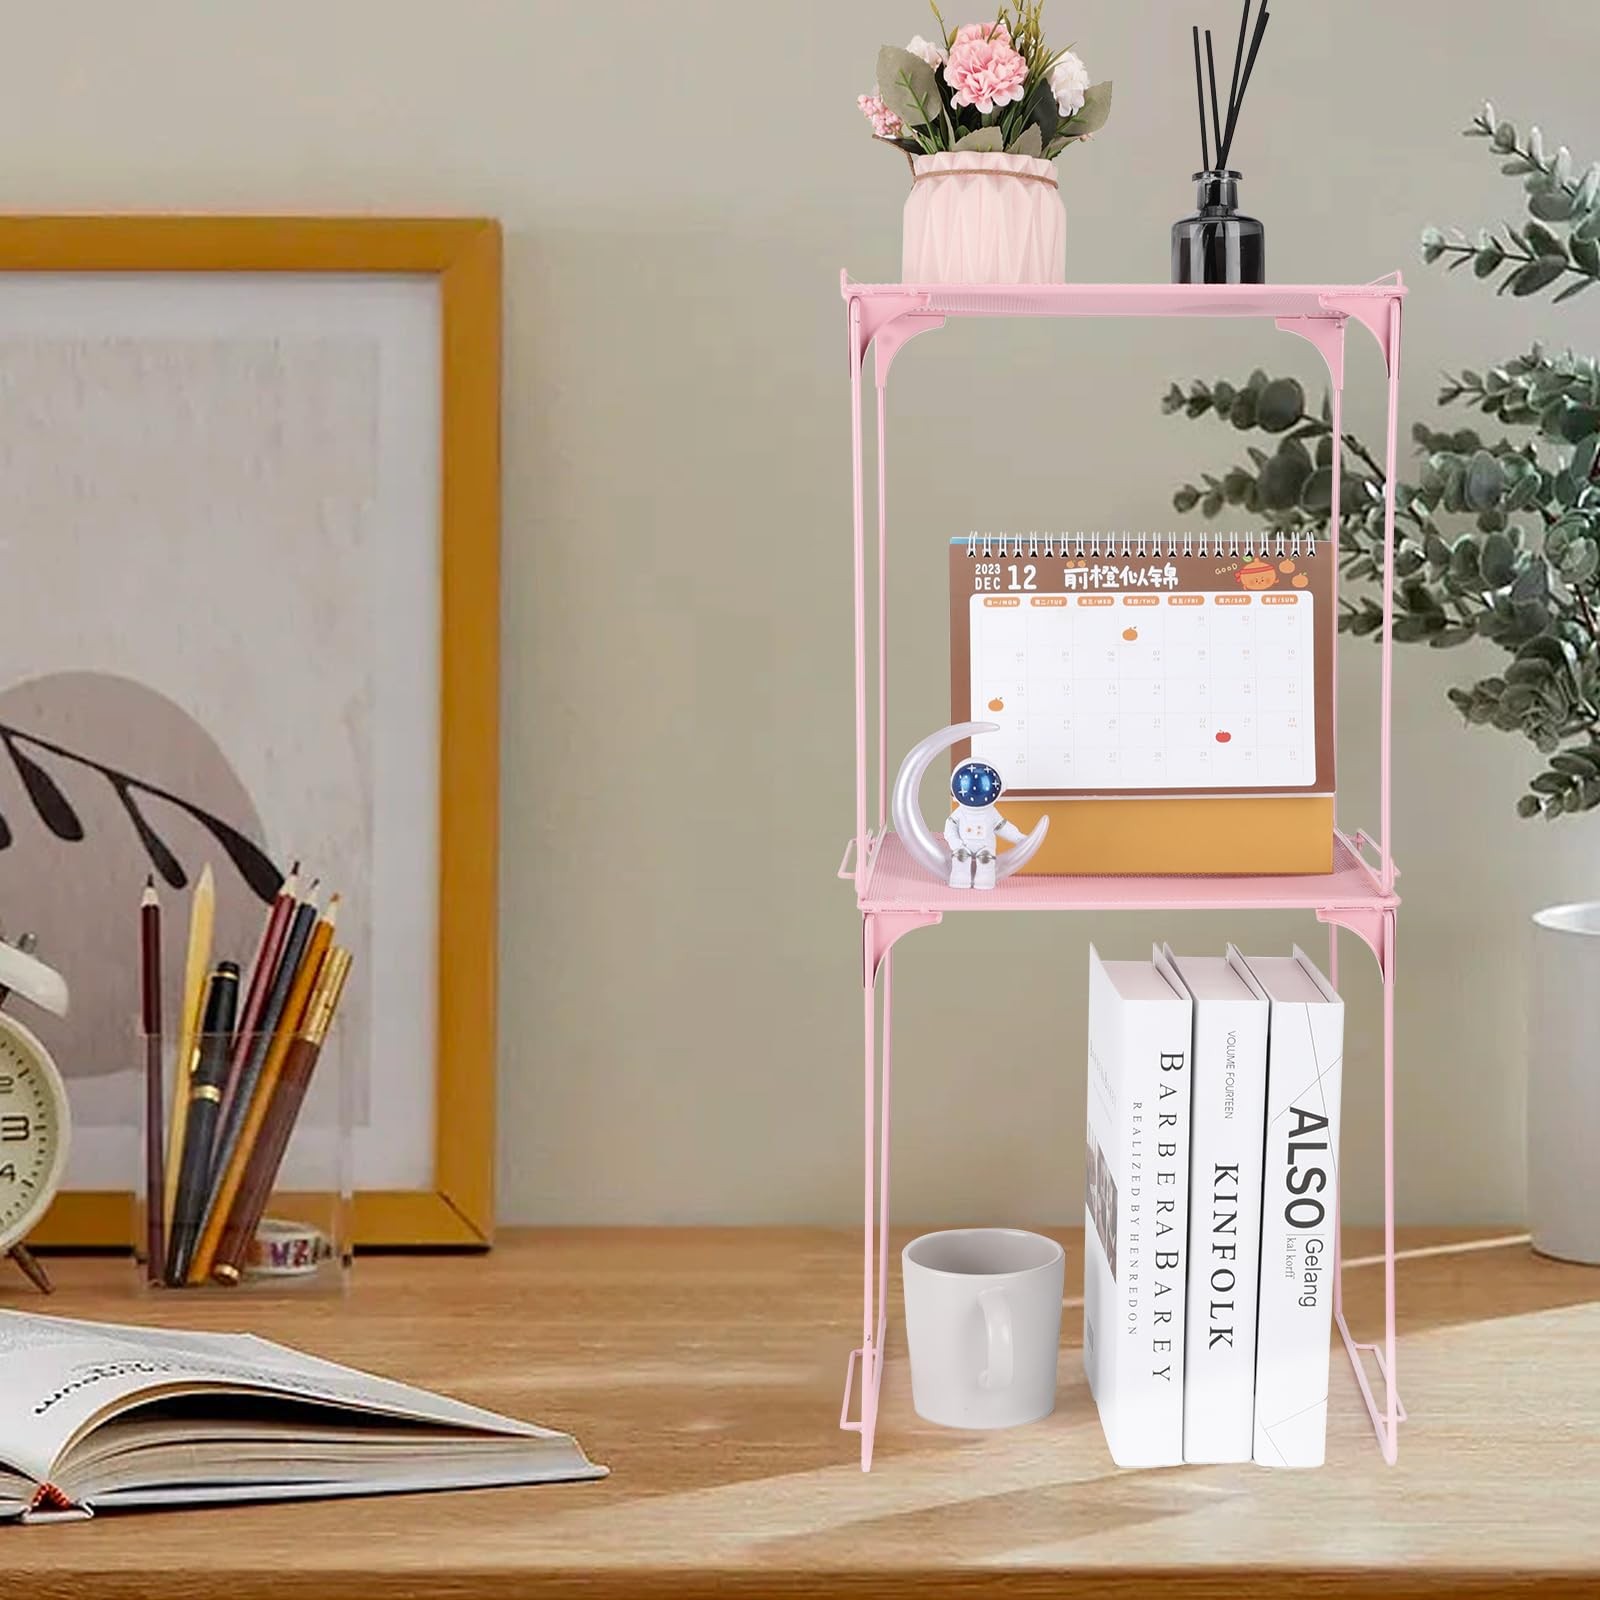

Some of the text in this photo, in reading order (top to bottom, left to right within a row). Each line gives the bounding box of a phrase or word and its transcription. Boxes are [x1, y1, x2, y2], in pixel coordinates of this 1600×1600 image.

[975, 563, 1001, 575] 2023
[975, 577, 1001, 590] DEC
[1007, 564, 1038, 591] 12
[1224, 1030, 1236, 1120] VOLUME FOURTEEN
[1, 1116, 30, 1141] 3
[1284, 1106, 1329, 1229] ALSO
[1128, 1102, 1143, 1335] REALIZED BY HENREDON
[1209, 1163, 1239, 1350] KINFOLK
[1286, 1237, 1297, 1252] kal
[1298, 1239, 1324, 1307] Gelang
